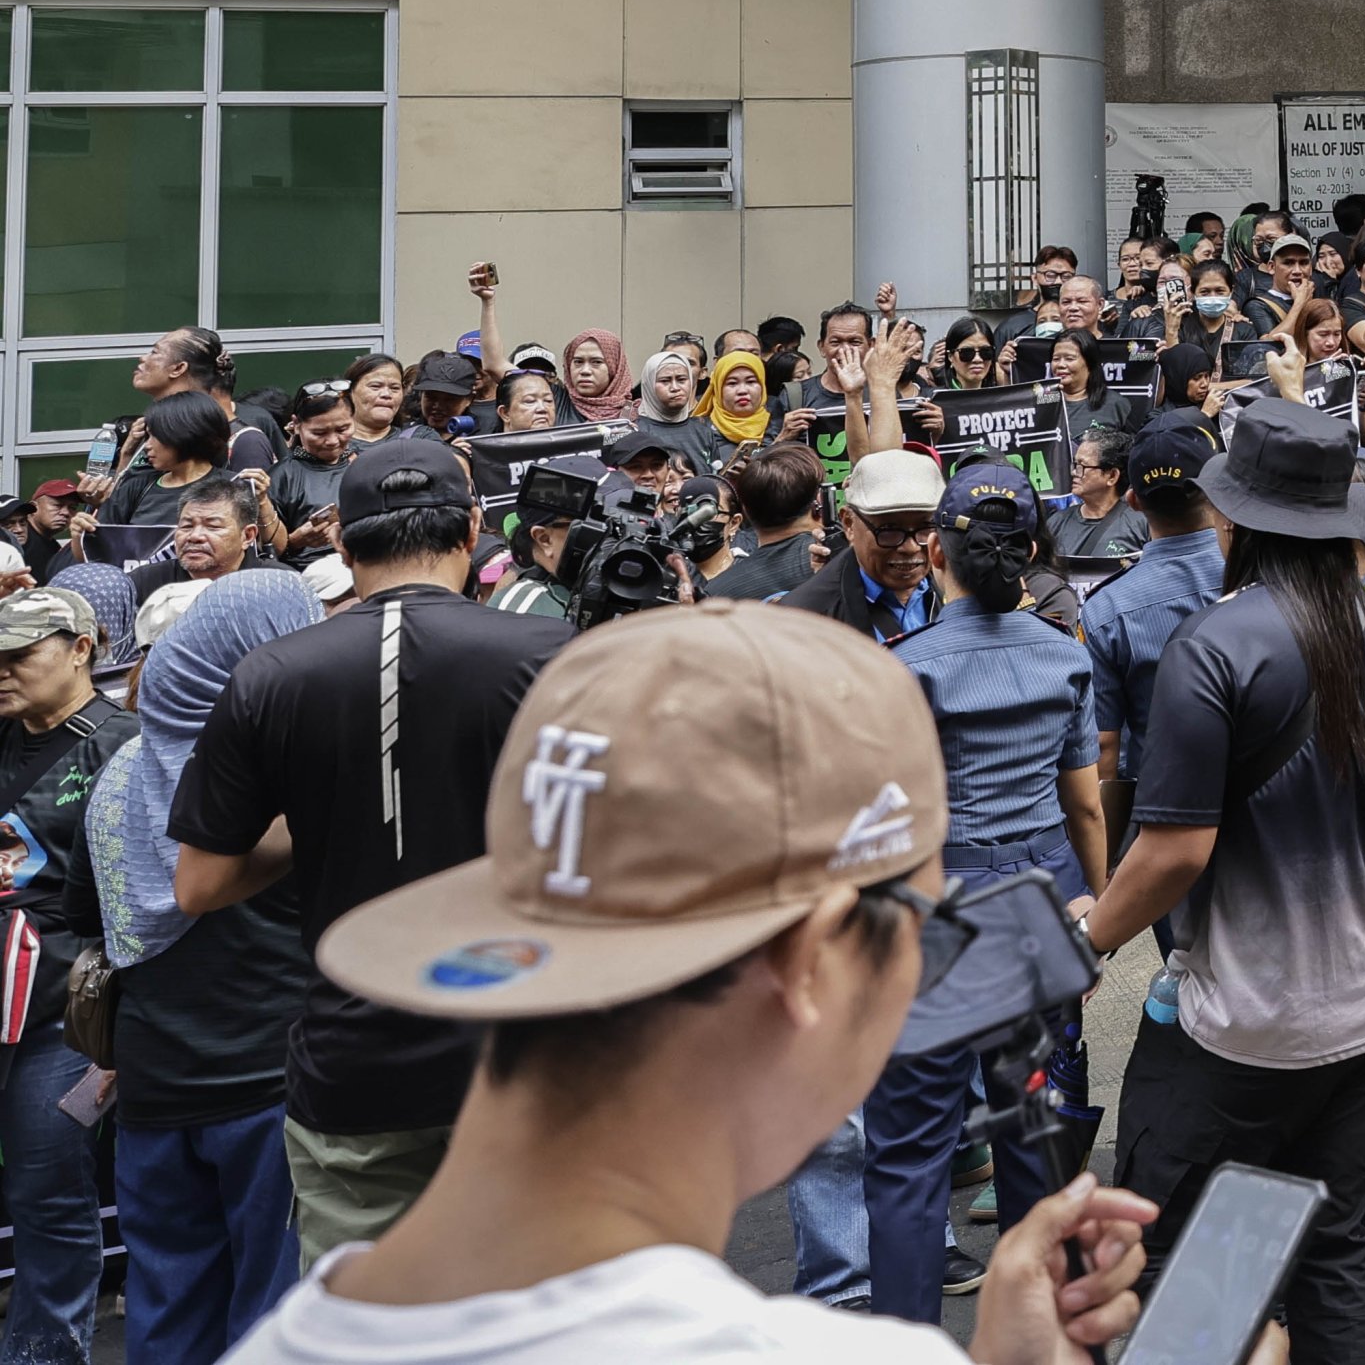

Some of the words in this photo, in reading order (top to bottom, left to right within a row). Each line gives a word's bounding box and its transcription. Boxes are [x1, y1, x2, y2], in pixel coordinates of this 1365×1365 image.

[1303, 112, 1338, 131] ALL
[1291, 142, 1319, 157] HALL
[1322, 142, 1338, 156] OF
[1290, 168, 1321, 178] Section
[1326, 167, 1336, 177] IV
[1341, 167, 1354, 178] (4)
[1291, 185, 1306, 195] No.
[1291, 199, 1323, 211] CARD
[1300, 216, 1330, 229] fficial
[958, 408, 1036, 436] PROTECT
[987, 432, 1012, 452] VP
[1143, 465, 1182, 484] PULIS
[970, 485, 1017, 499] PULIS
